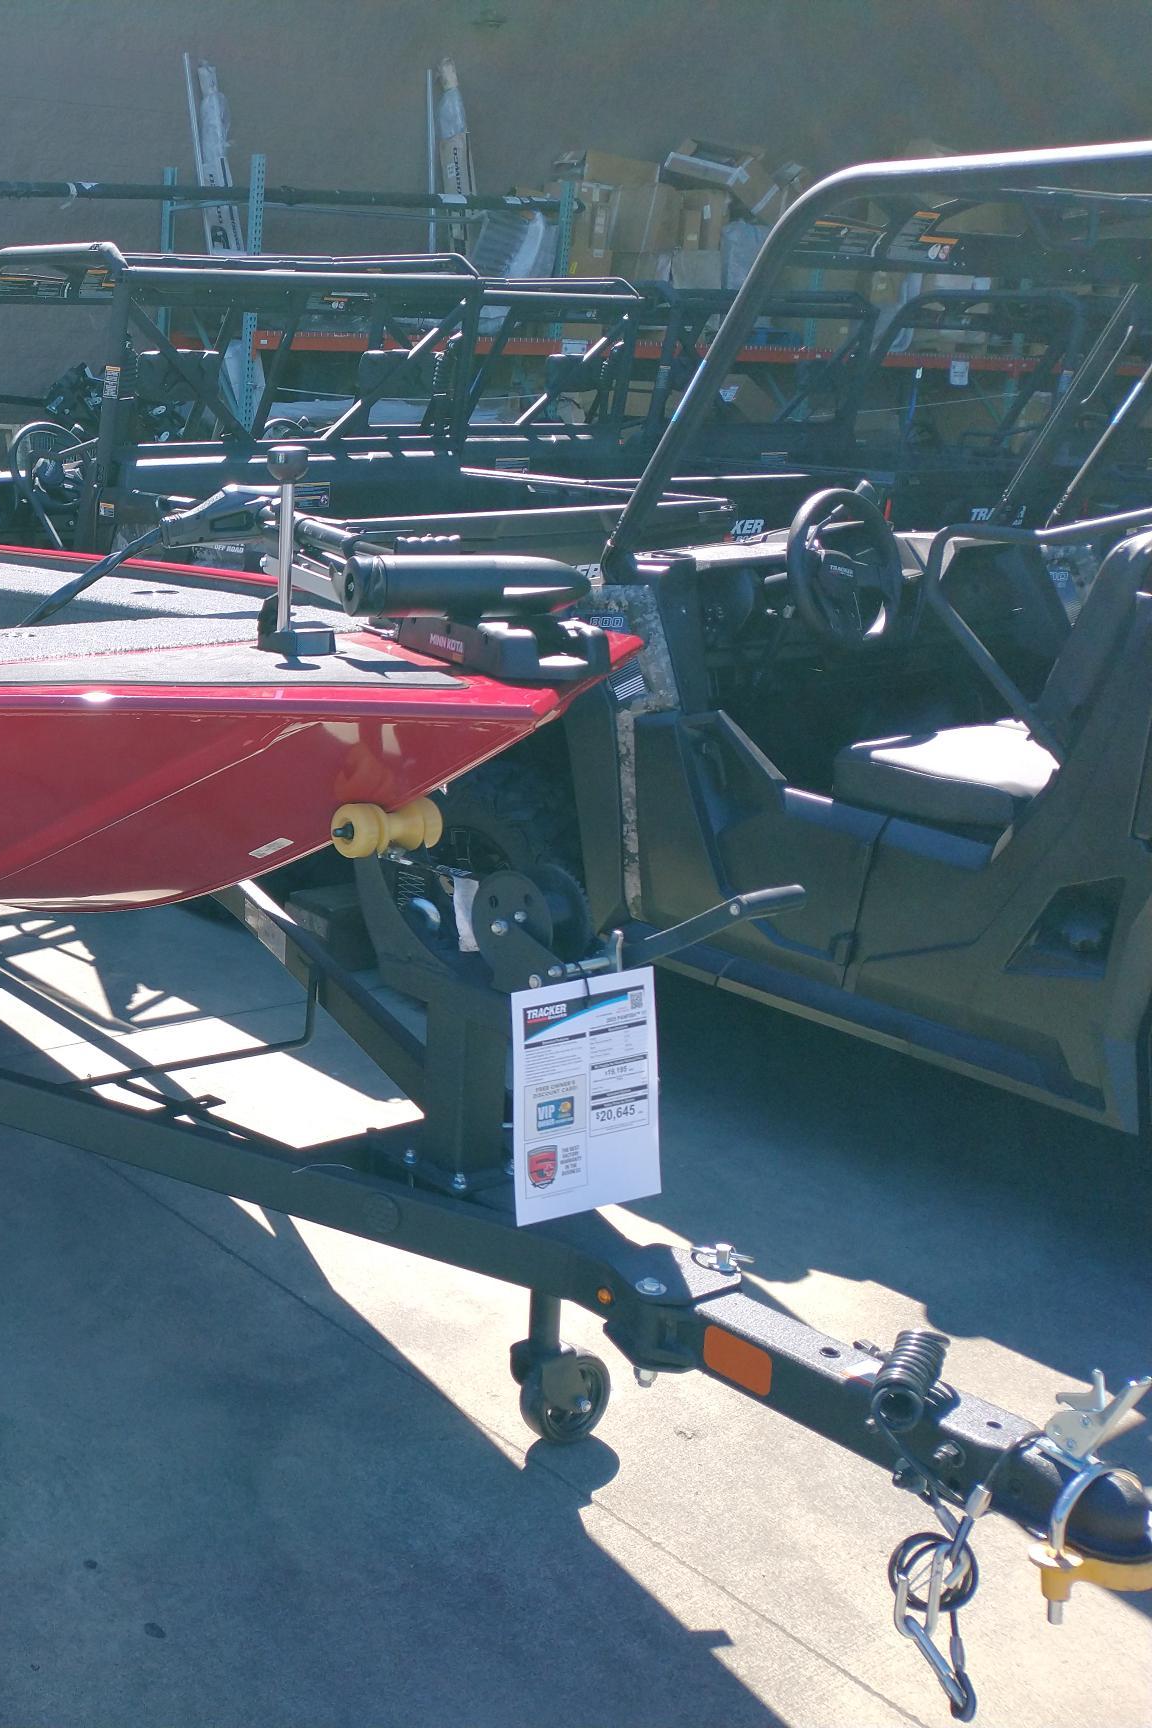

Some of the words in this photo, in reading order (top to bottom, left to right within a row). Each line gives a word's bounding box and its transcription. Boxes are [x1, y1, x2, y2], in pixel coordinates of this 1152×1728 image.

[429, 632, 447, 649] MINN
[447, 638, 464, 654] KOTA
[526, 1003, 567, 1020] TRACKER
[538, 1104, 555, 1121] VIP
[595, 1104, 636, 1122] $20,645
